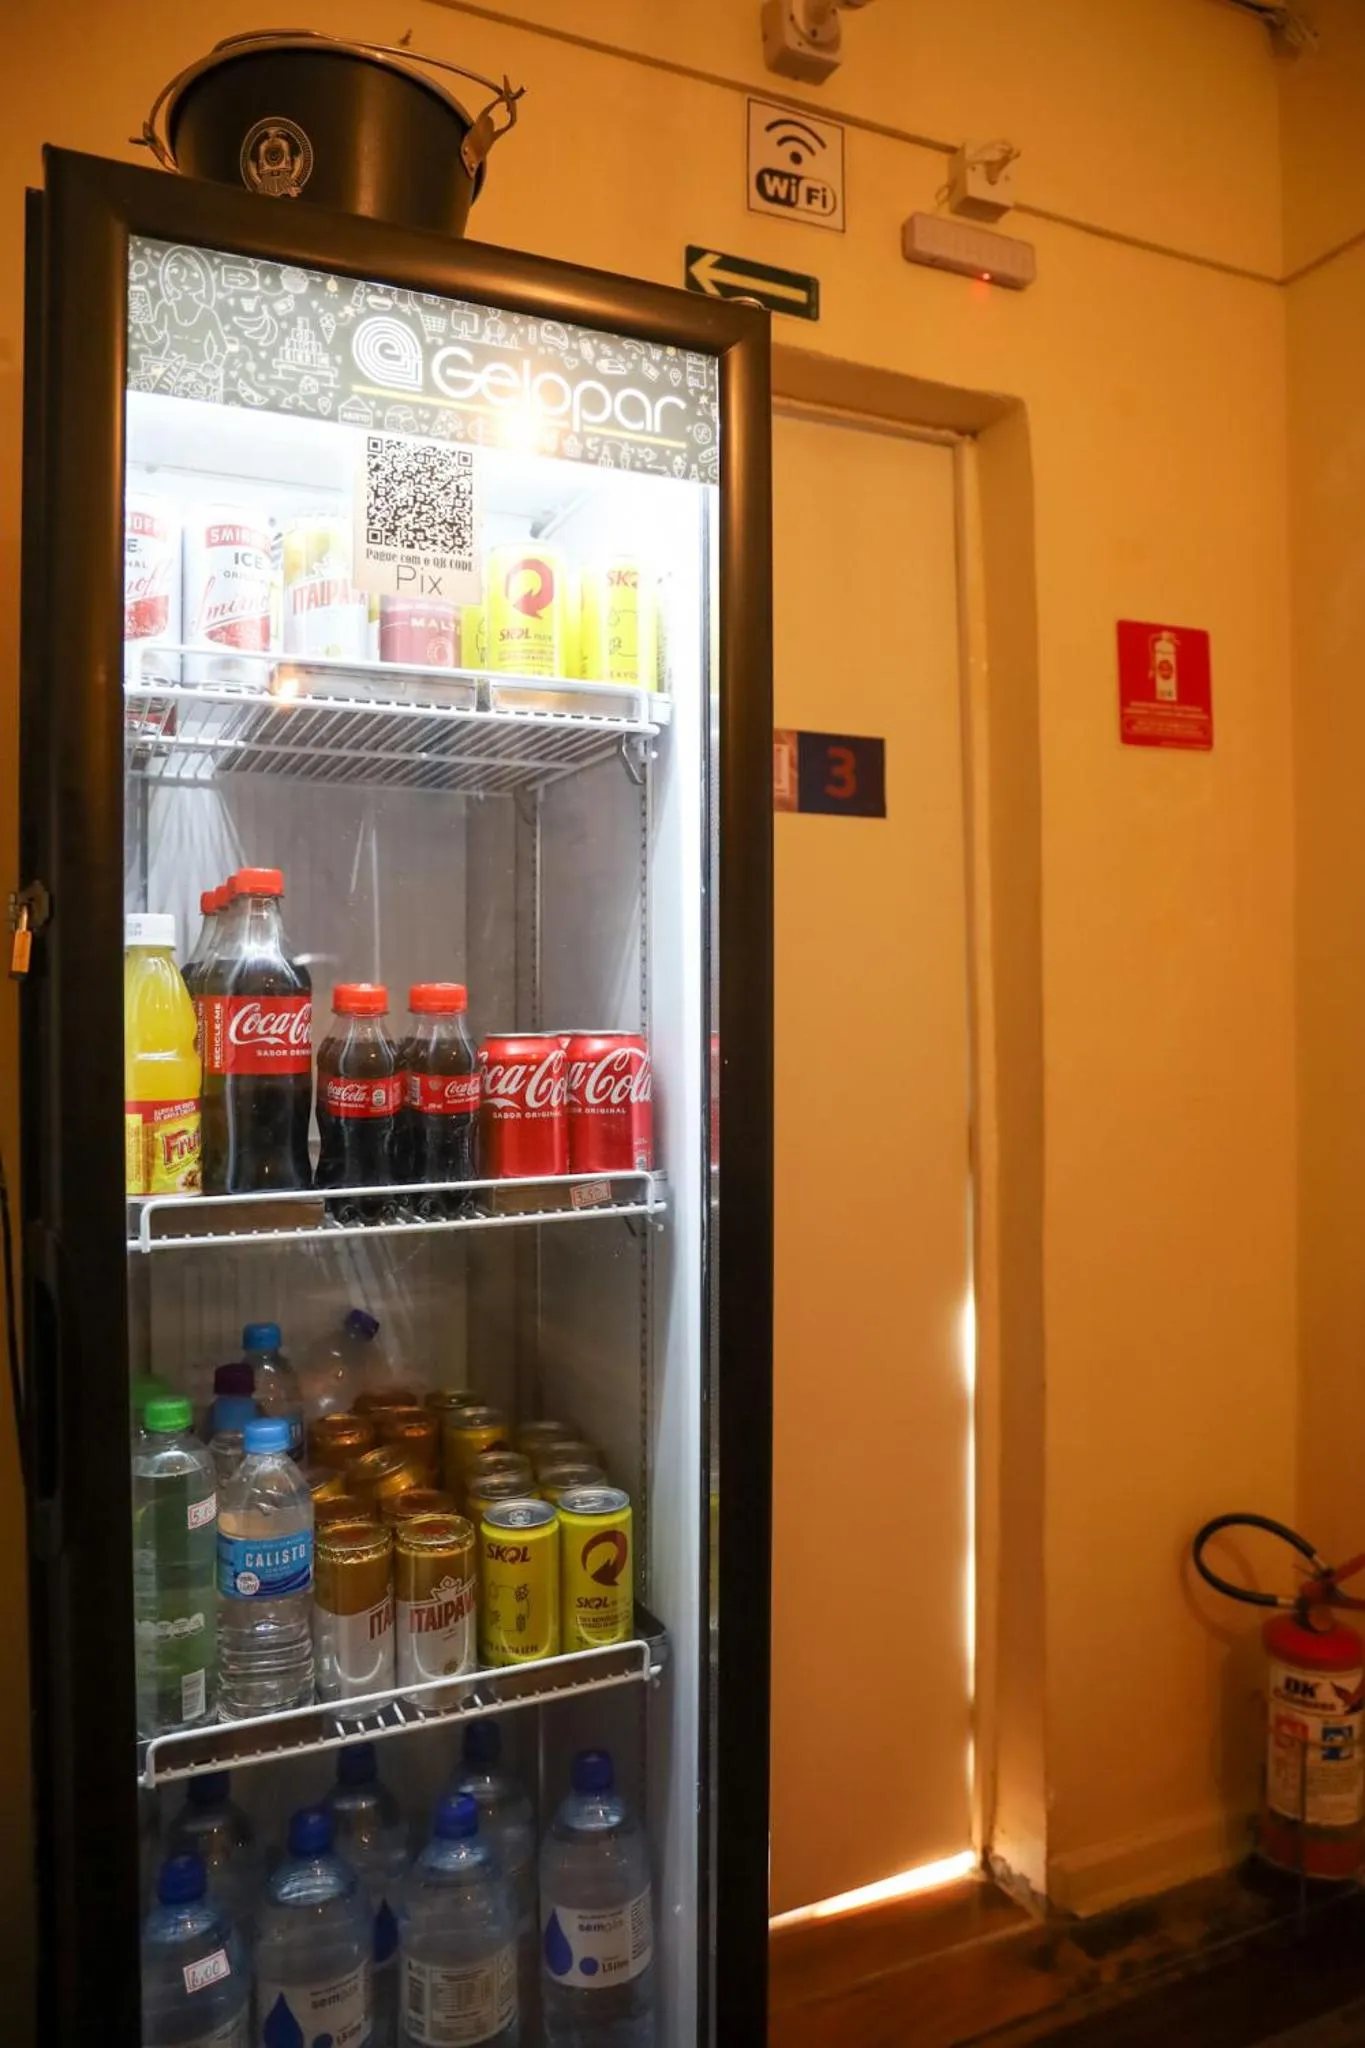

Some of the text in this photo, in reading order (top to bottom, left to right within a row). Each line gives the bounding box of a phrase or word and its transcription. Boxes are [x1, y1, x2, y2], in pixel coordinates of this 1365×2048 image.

[431, 346, 687, 433] Gelopar
[234, 552, 264, 570] ICE
[366, 548, 397, 562] Pague
[400, 554, 421, 565] com
[424, 557, 431, 566] o
[396, 564, 443, 597] Pix
[823, 744, 857, 799] 3
[228, 1002, 312, 1046] Coca-Co
[493, 1111, 522, 1119] SABOR
[585, 1107, 626, 1116] ORIGINAL
[245, 1543, 306, 1569] CALISTO
[487, 1543, 531, 1564] SKOL
[576, 1596, 610, 1611] SKOL
